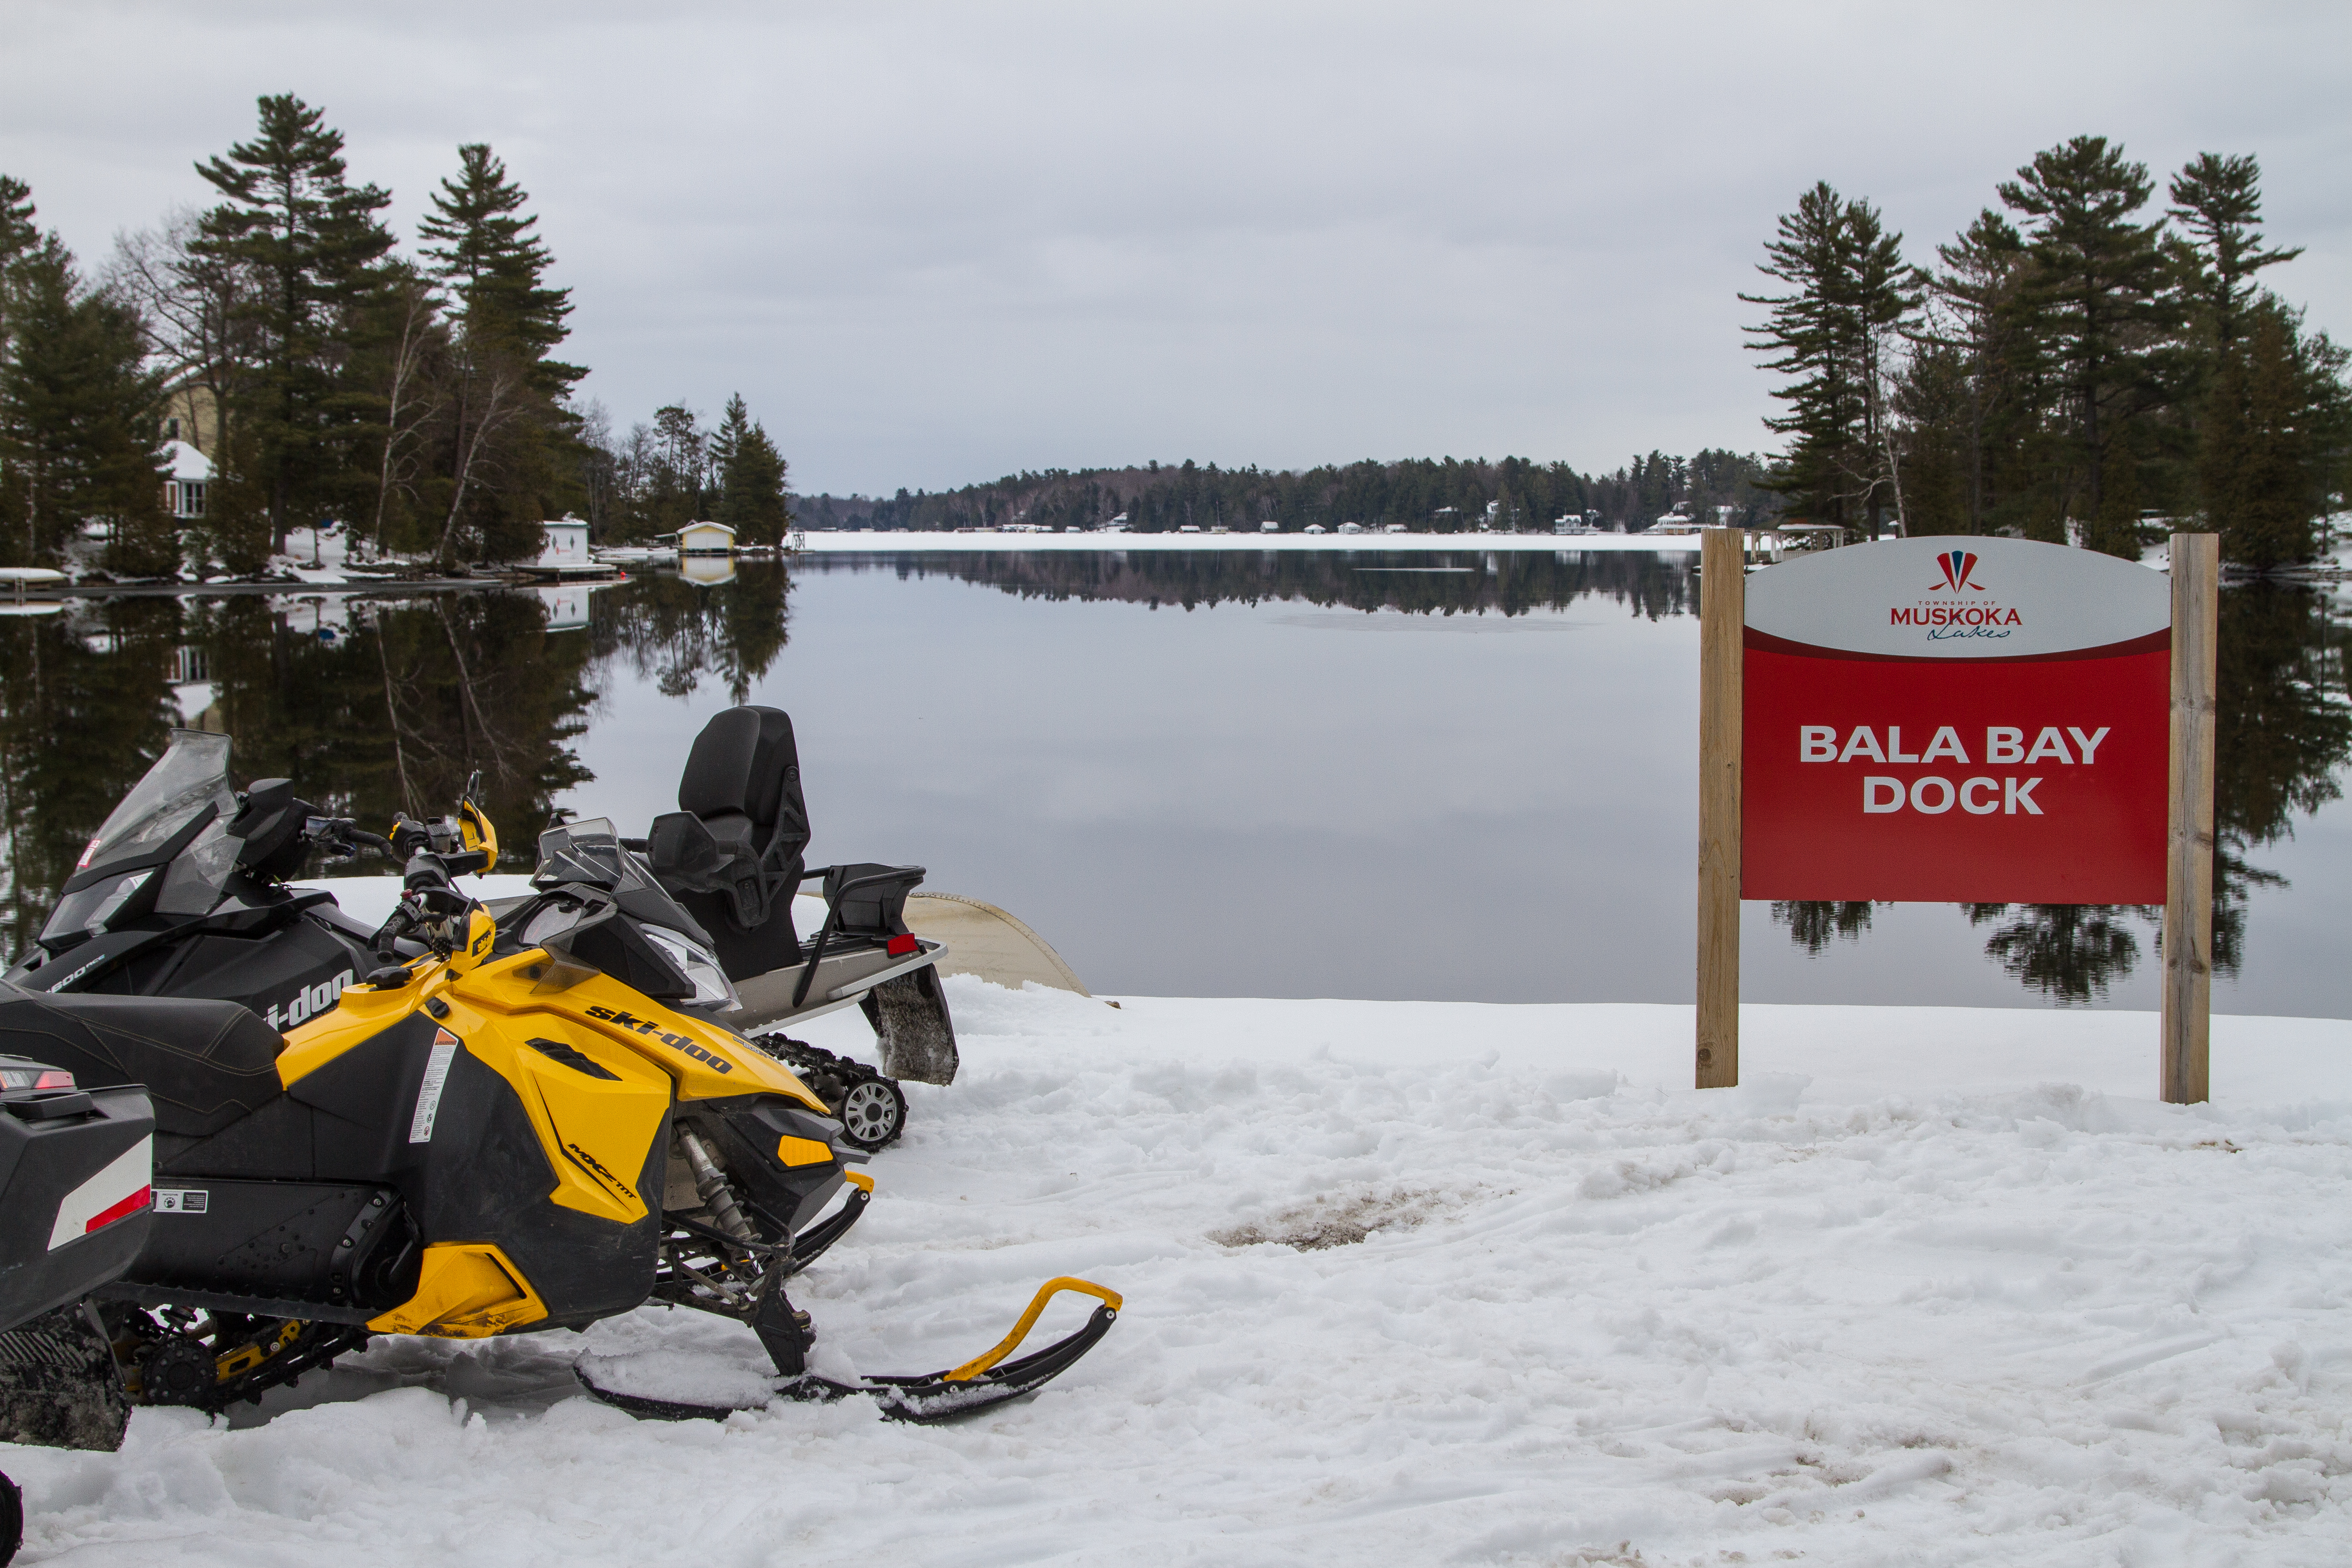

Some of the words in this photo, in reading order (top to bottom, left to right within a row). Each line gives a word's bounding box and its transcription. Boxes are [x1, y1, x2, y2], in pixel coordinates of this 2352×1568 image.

[1891, 608, 2023, 625] MUSKOKA
[1927, 614, 2010, 640] Lakes
[1800, 725, 1970, 763] BALA
[1987, 727, 2111, 764] BAY
[1864, 776, 2044, 814] DOCK
[51, 966, 86, 993] 600
[585, 1005, 733, 1074] ski-doo
